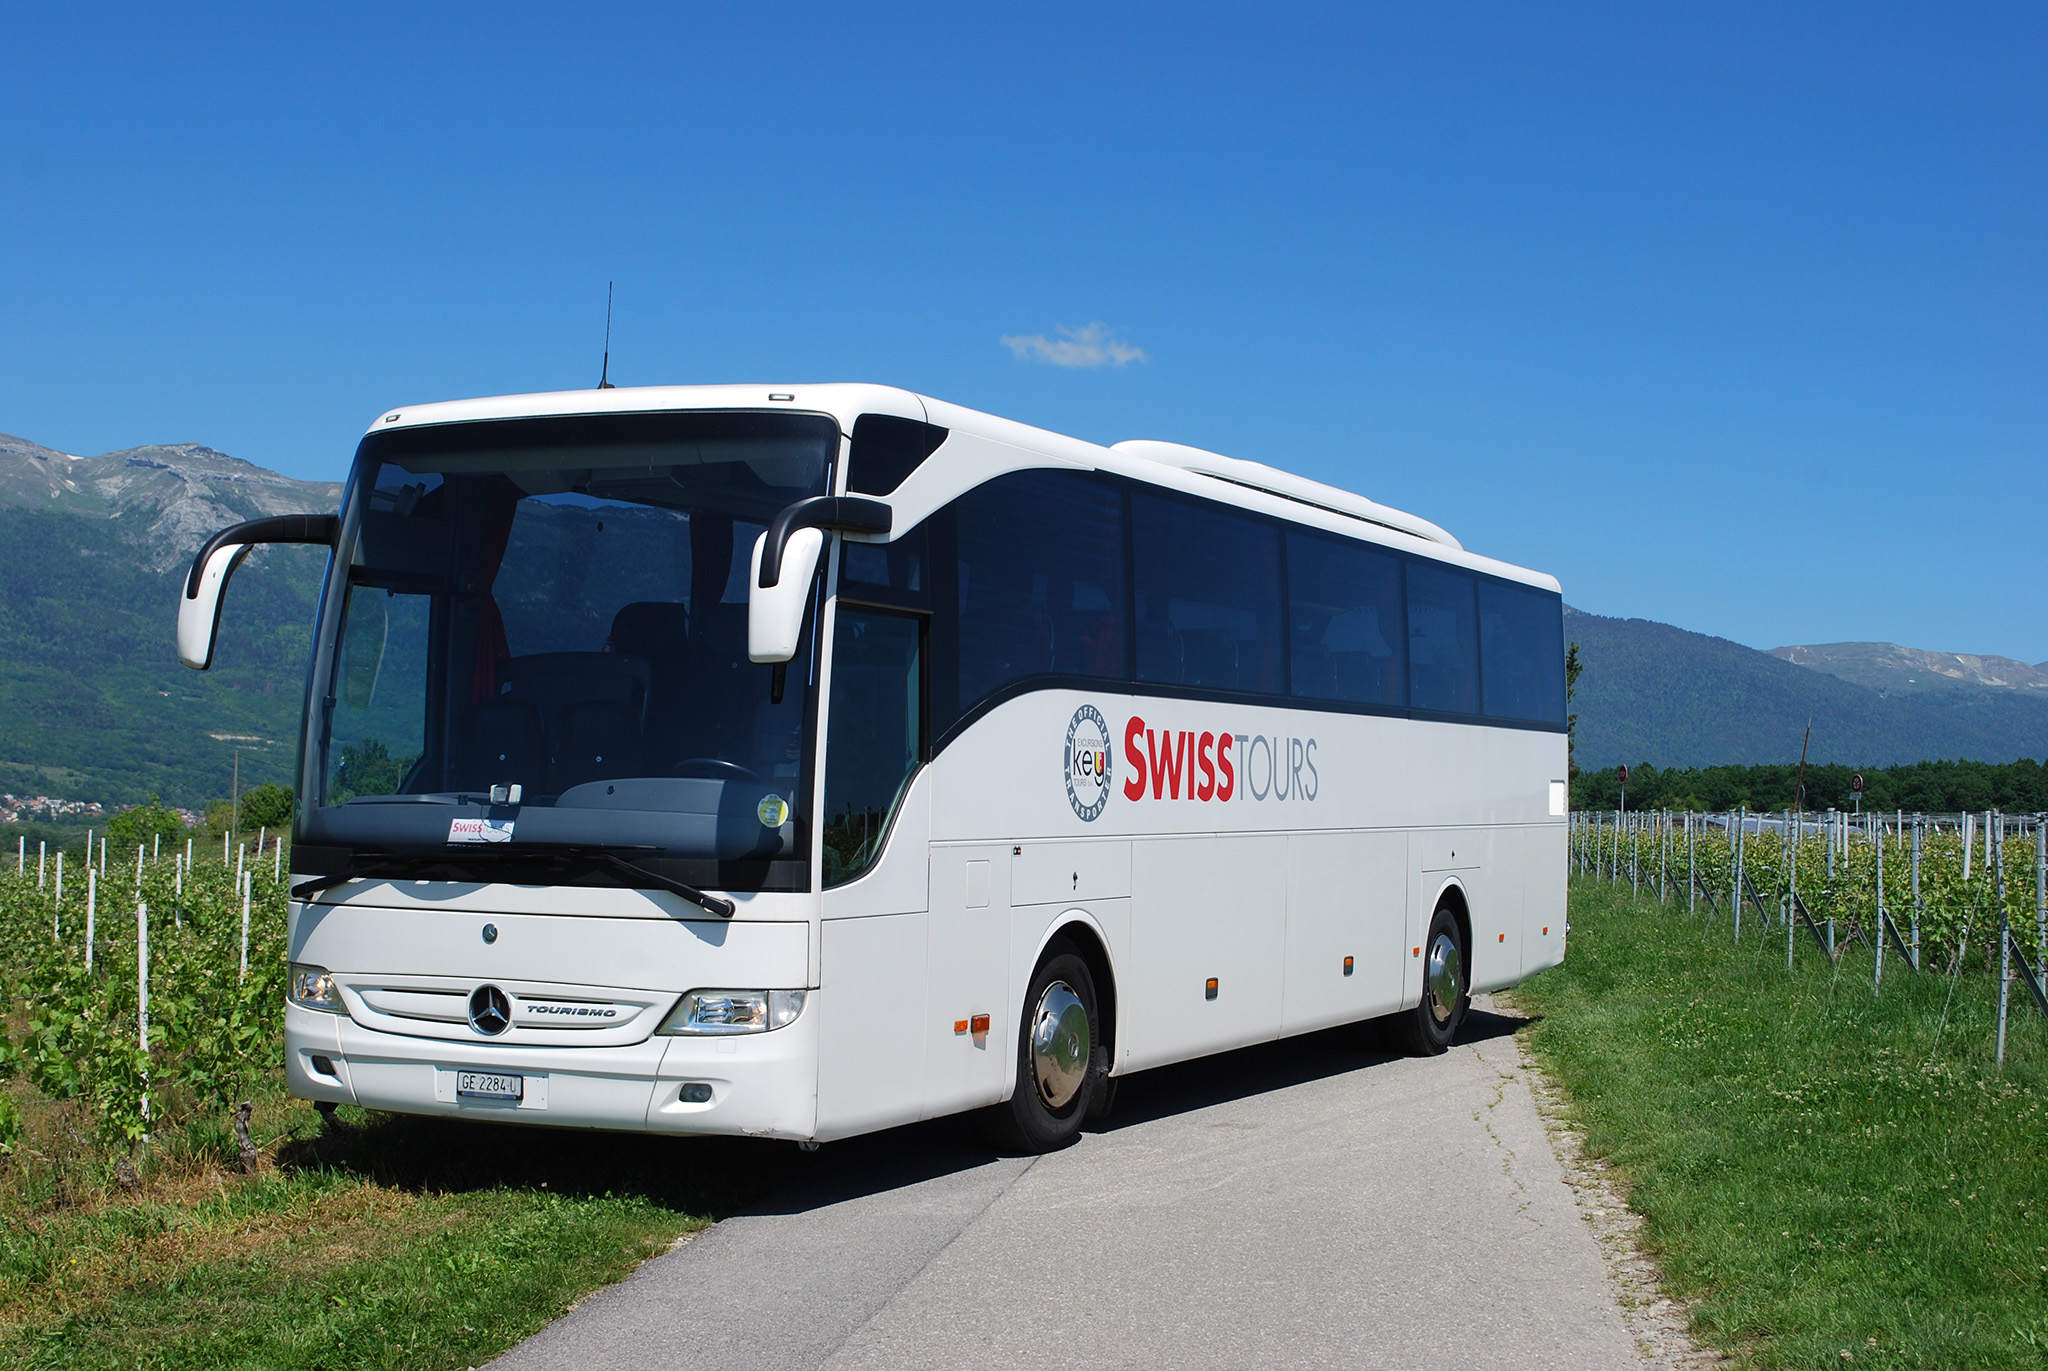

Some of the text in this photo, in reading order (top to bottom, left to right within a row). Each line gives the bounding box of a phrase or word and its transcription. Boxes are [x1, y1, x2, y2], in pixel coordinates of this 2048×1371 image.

[1065, 706, 1110, 751] THE OFFICIAL
[1073, 738, 1105, 787] key
[1123, 716, 1319, 803] SWISSTOURS
[1065, 766, 1112, 820] TRANSPORTER
[527, 1005, 617, 1017] TOURISMO
[463, 1074, 476, 1090] GE
[480, 1076, 506, 1092] 2284
